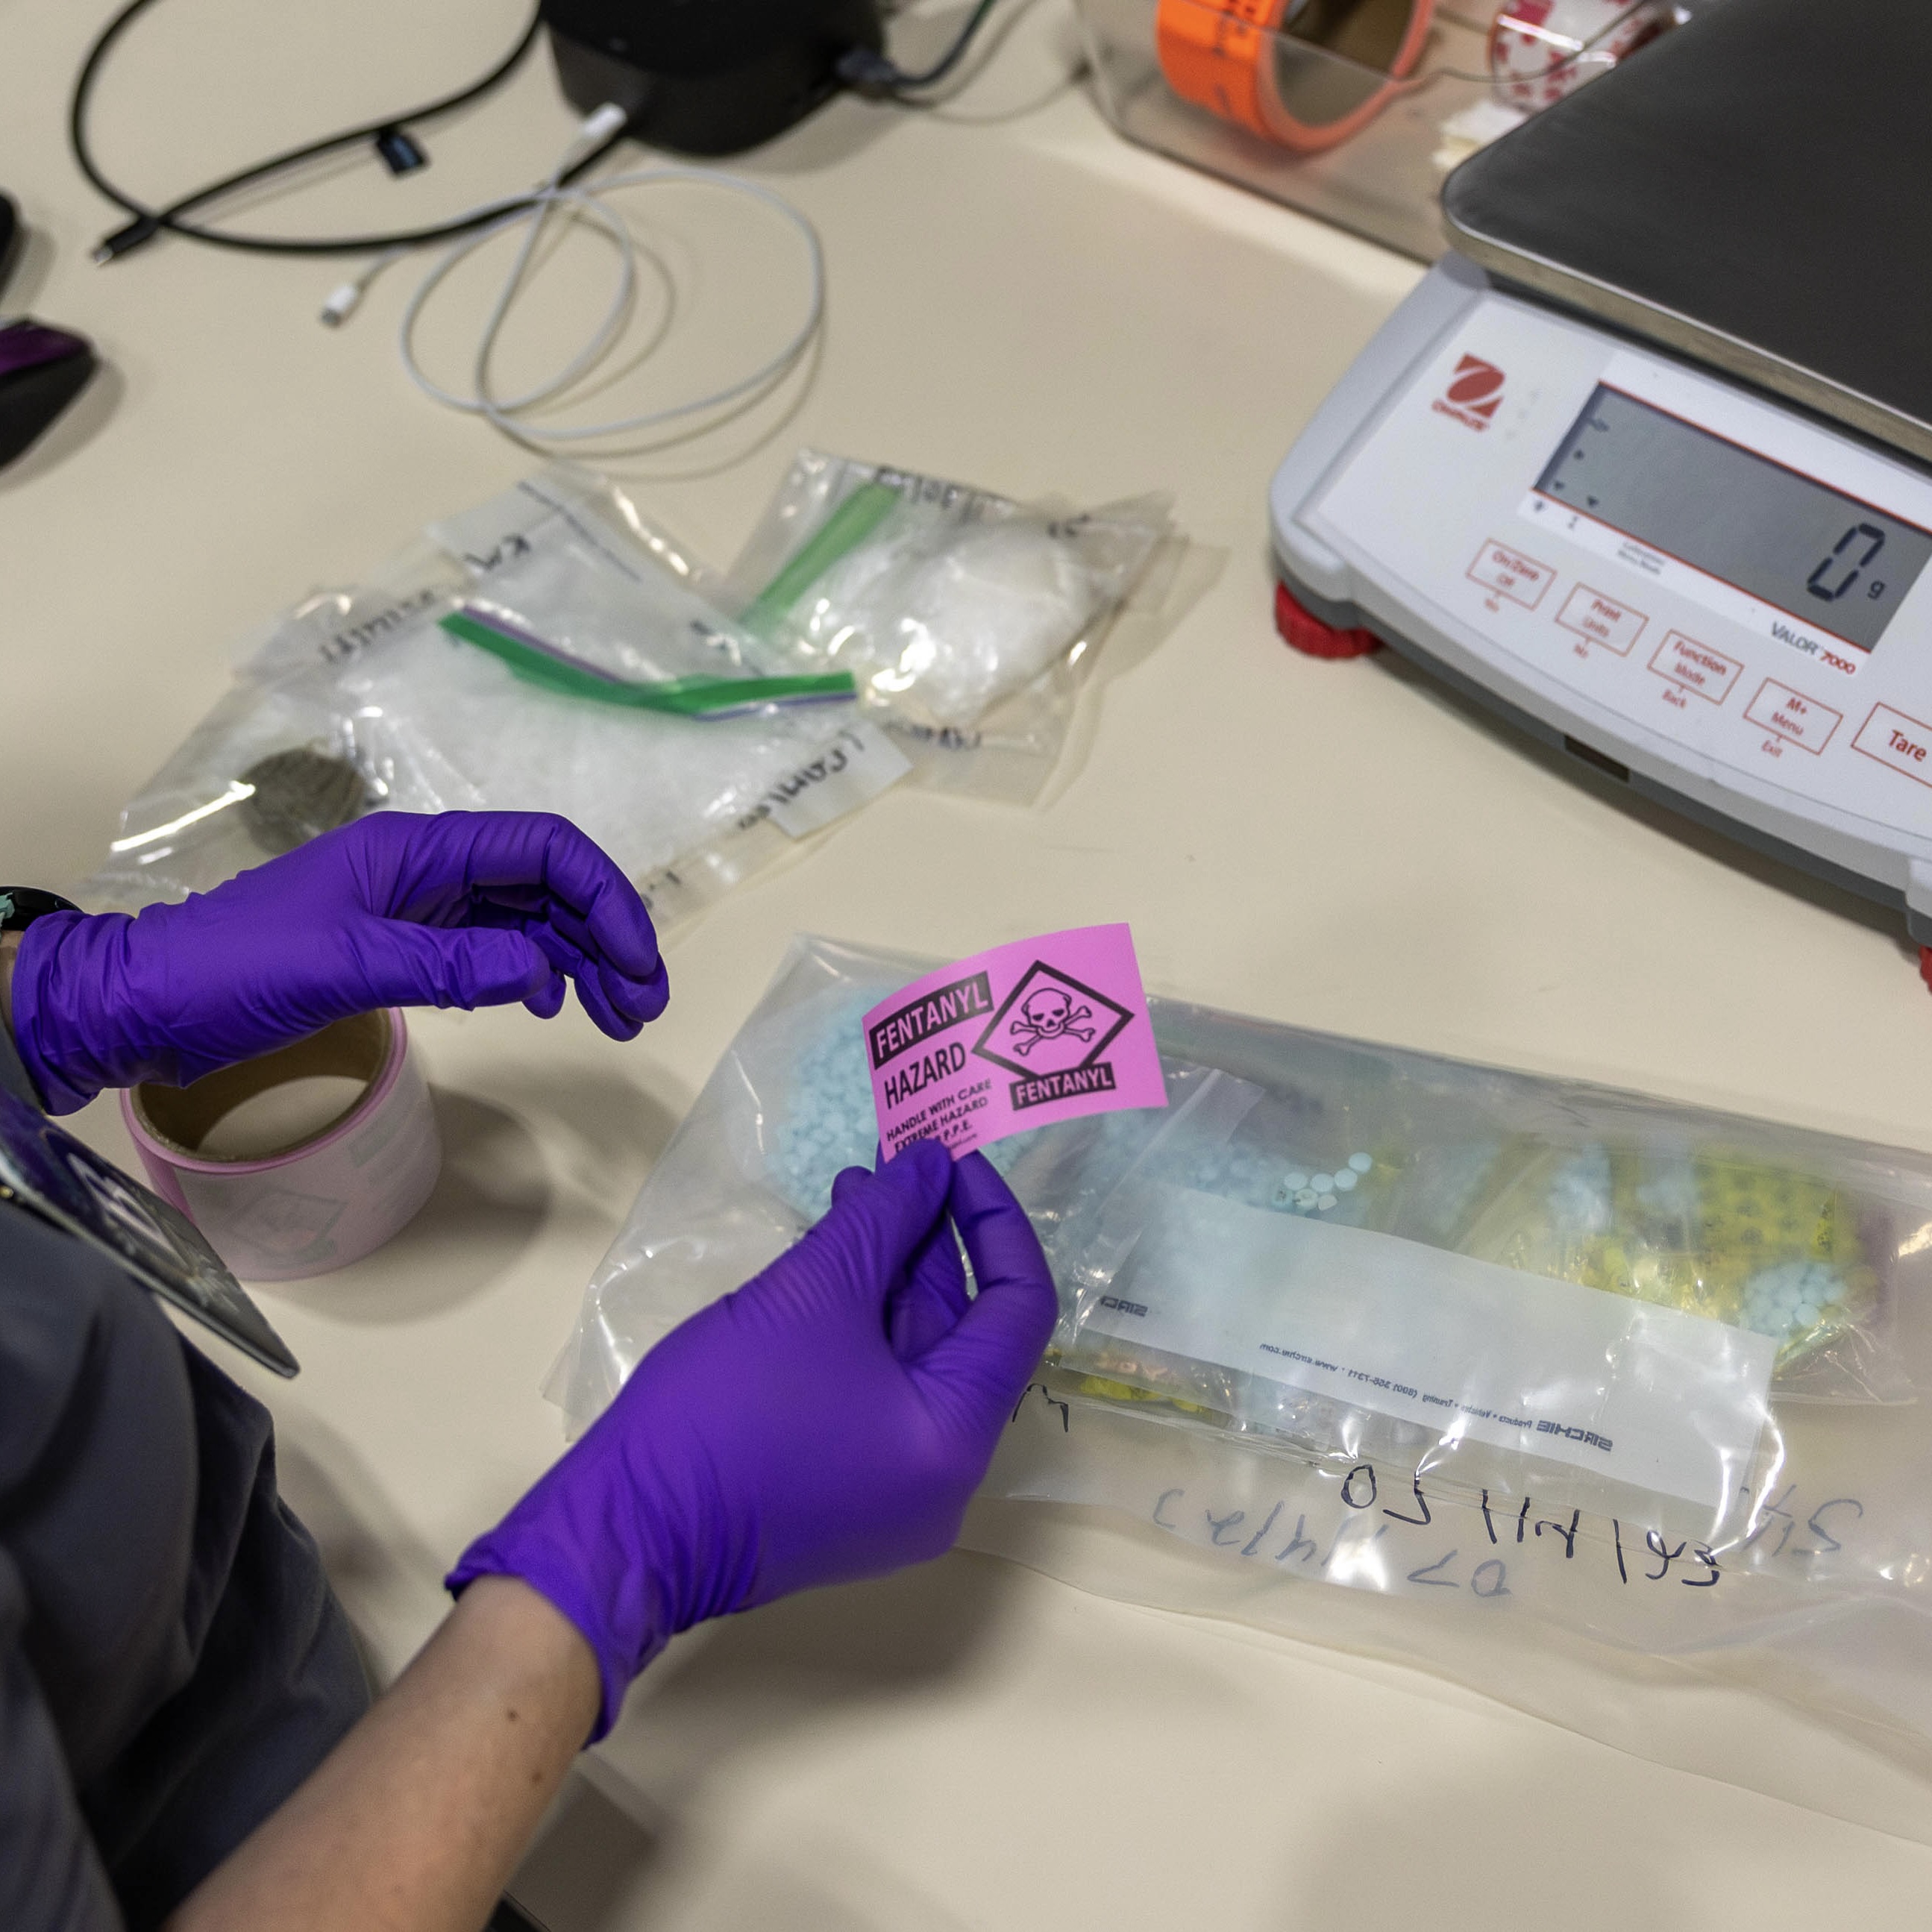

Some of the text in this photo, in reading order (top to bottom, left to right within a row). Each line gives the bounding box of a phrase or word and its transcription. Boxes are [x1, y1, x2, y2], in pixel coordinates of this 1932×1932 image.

[1806, 523, 1886, 602] 0 g
[1673, 640, 1727, 677] Function
[1771, 621, 1856, 674] VALOR 7000
[1675, 662, 1706, 686] Mode
[1771, 711, 1804, 736] Menu
[1889, 729, 1927, 762] Tare
[1761, 739, 1783, 758] Exit
[876, 981, 988, 1058] FENTANYL
[884, 1042, 965, 1109] HAZARD
[1015, 1067, 1112, 1105] FENTANYL
[886, 1110, 926, 1141] HANDLE
[929, 1094, 955, 1115] WITH
[958, 1078, 991, 1100] CARE
[894, 1119, 938, 1153] EXTREME
[940, 1097, 988, 1126] HAZARD
